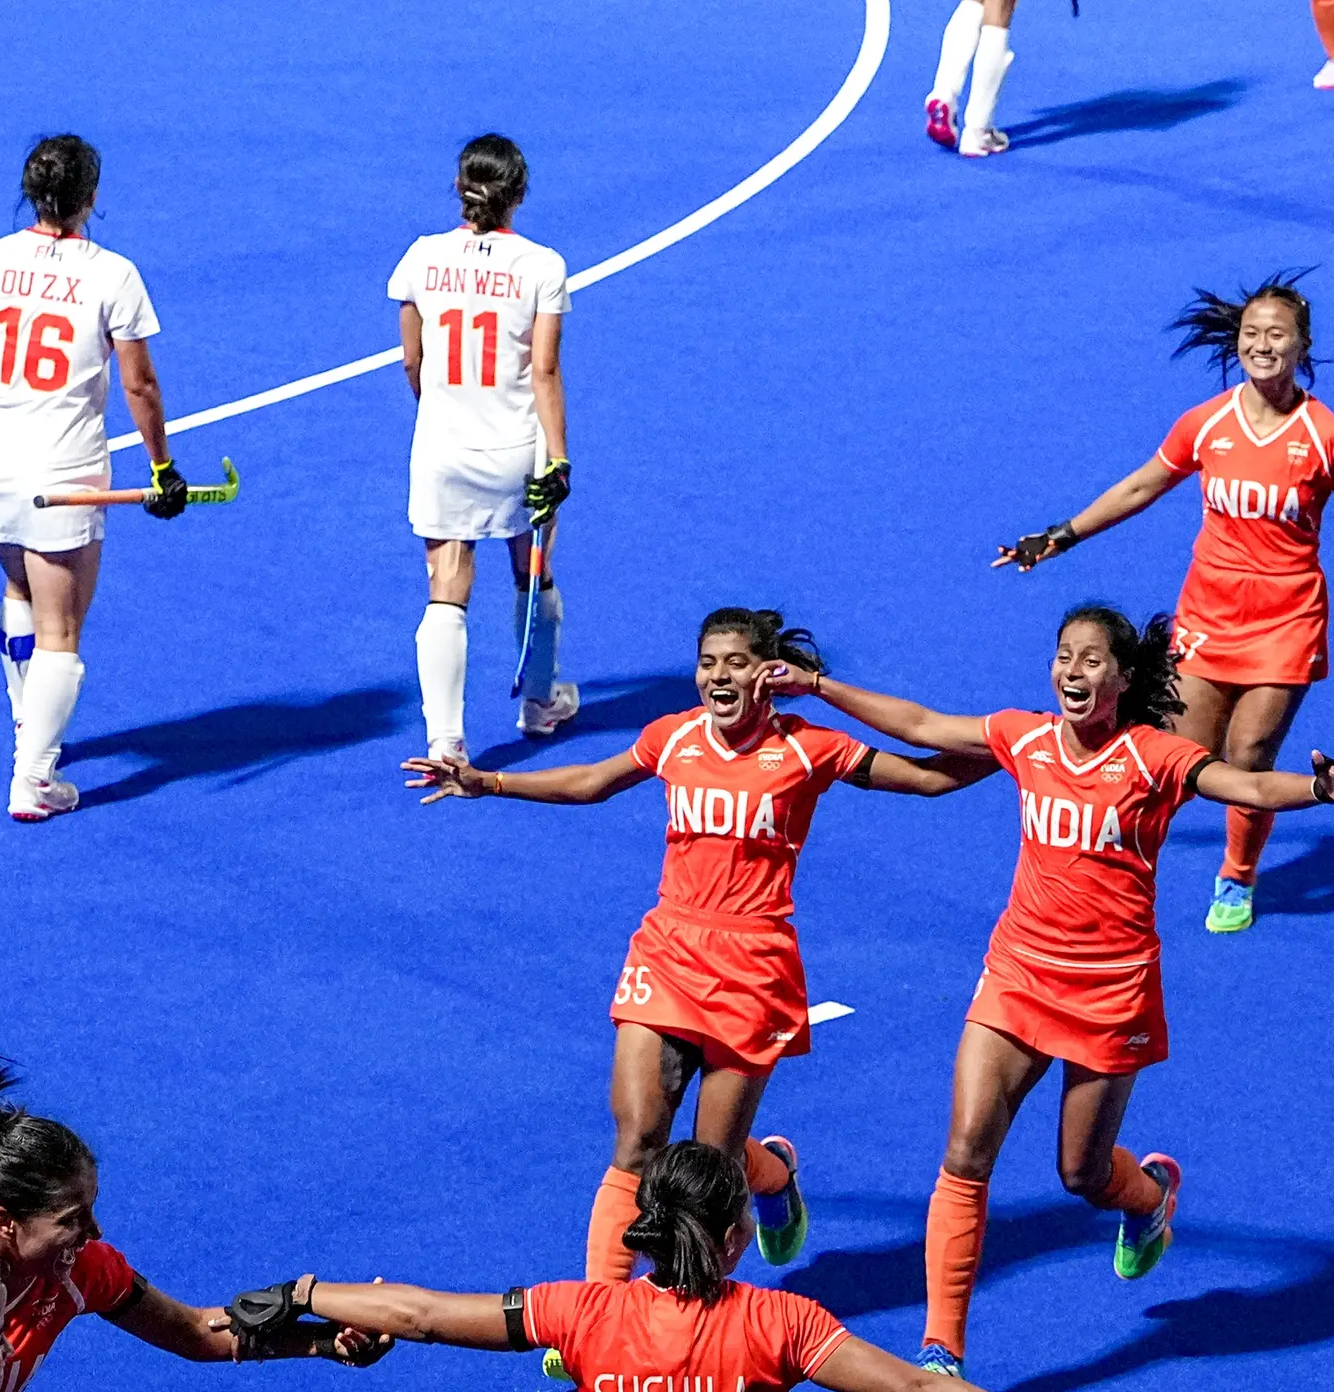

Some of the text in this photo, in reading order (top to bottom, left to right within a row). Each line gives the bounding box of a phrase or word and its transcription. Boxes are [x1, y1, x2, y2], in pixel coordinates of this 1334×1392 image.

[1, 269, 83, 305] OU Z.X.
[425, 265, 522, 300] DAN WEN
[439, 308, 498, 387] 11
[1207, 476, 1300, 525] INDIA
[670, 785, 776, 840] INDIA
[1021, 787, 1124, 853] INDIA
[615, 966, 653, 1005] 35
